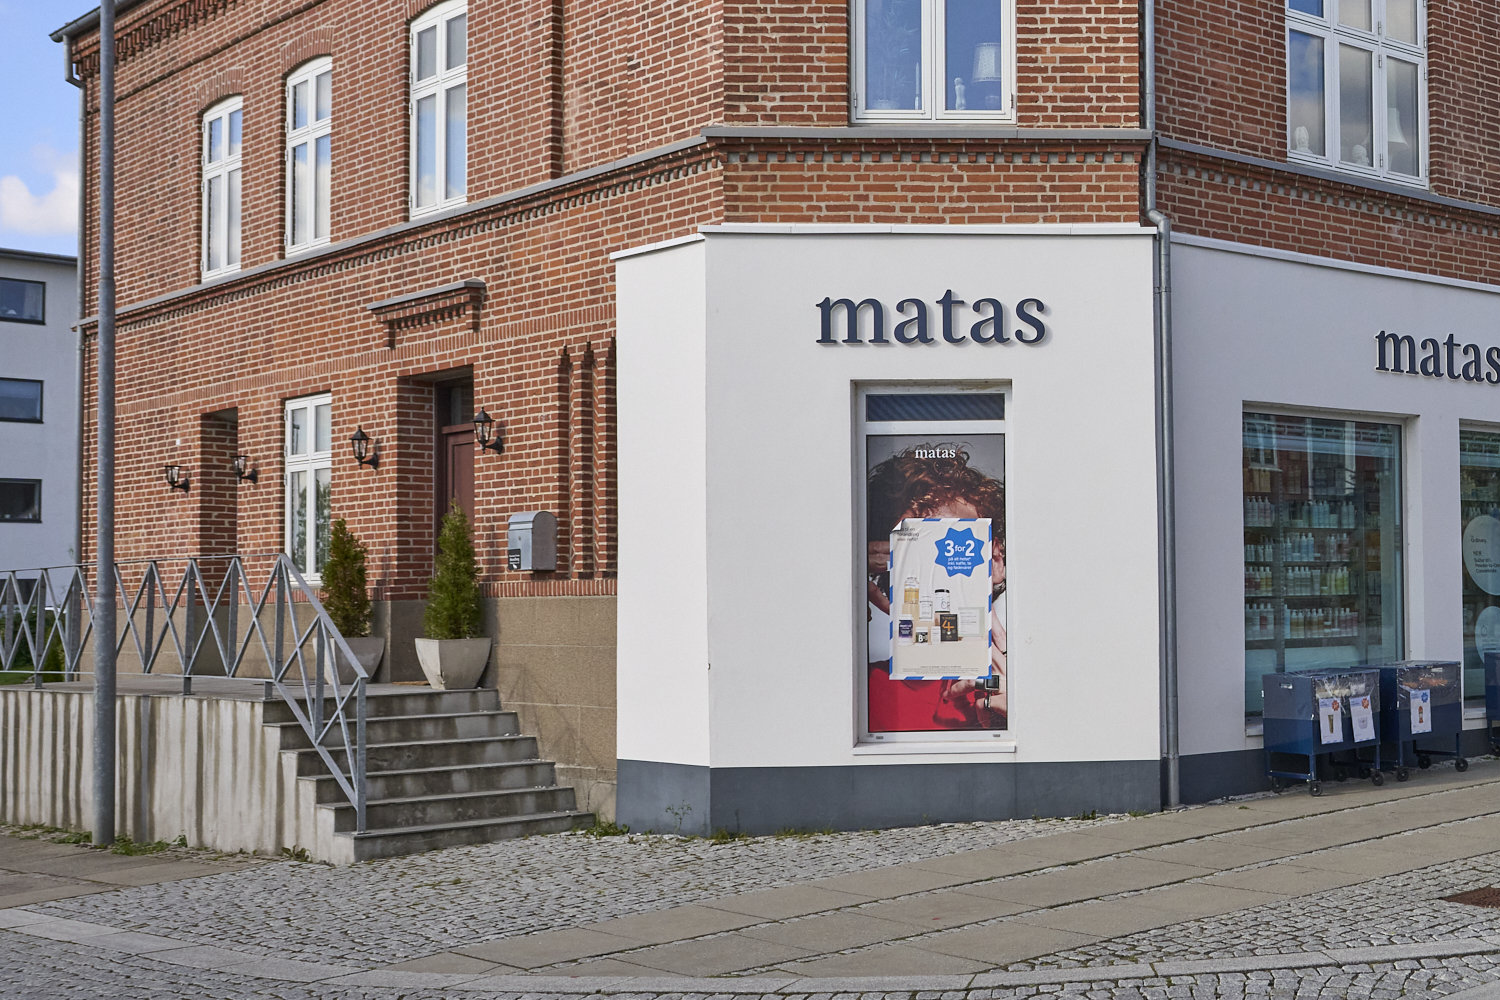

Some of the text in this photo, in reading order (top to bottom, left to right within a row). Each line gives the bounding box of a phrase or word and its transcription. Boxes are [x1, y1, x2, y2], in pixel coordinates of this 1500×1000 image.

[815, 289, 1047, 345] matas
[914, 446, 956, 459] matas
[944, 540, 975, 557] 3 for 2
